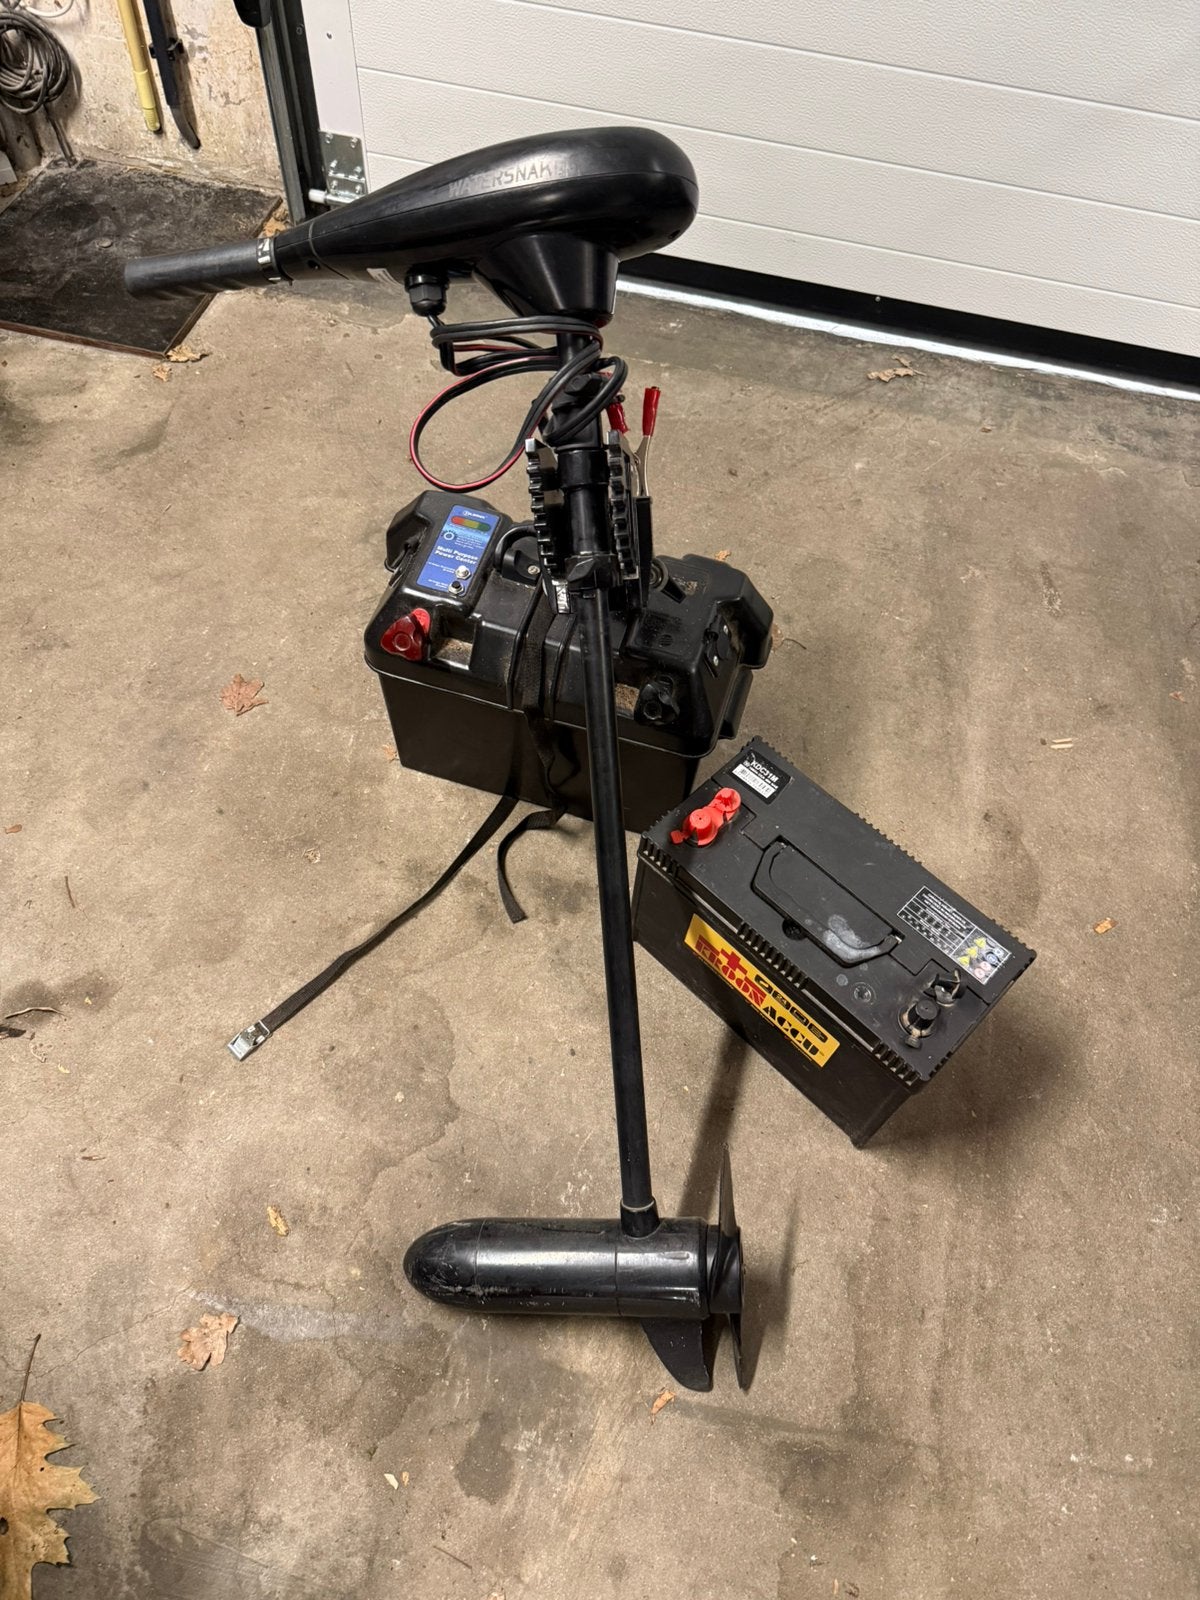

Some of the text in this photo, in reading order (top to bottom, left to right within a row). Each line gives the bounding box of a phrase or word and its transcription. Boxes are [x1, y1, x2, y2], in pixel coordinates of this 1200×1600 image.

[434, 550, 477, 565] Power Center
[437, 545, 479, 561] Multi Purpose
[695, 934, 767, 1007] KROON
[762, 1005, 820, 1056] ACCU
